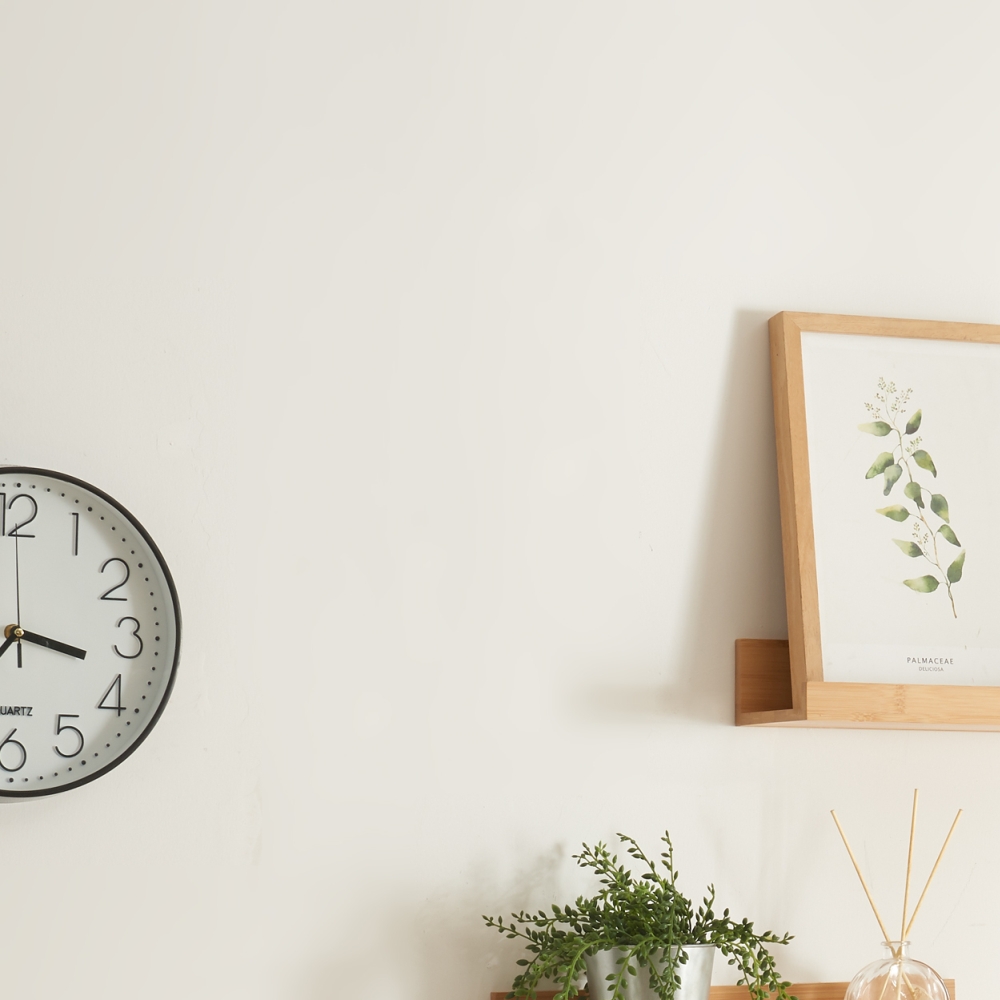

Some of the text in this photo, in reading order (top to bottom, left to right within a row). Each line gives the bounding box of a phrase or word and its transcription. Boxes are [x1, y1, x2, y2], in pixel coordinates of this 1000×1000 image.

[0, 493, 38, 538] 12
[71, 512, 79, 556] 1
[100, 557, 130, 602] 2
[113, 616, 143, 659] 3
[906, 656, 954, 665] PALMACEAE
[97, 673, 127, 717] 4
[0, 727, 27, 773] 6
[54, 714, 84, 758] 5
